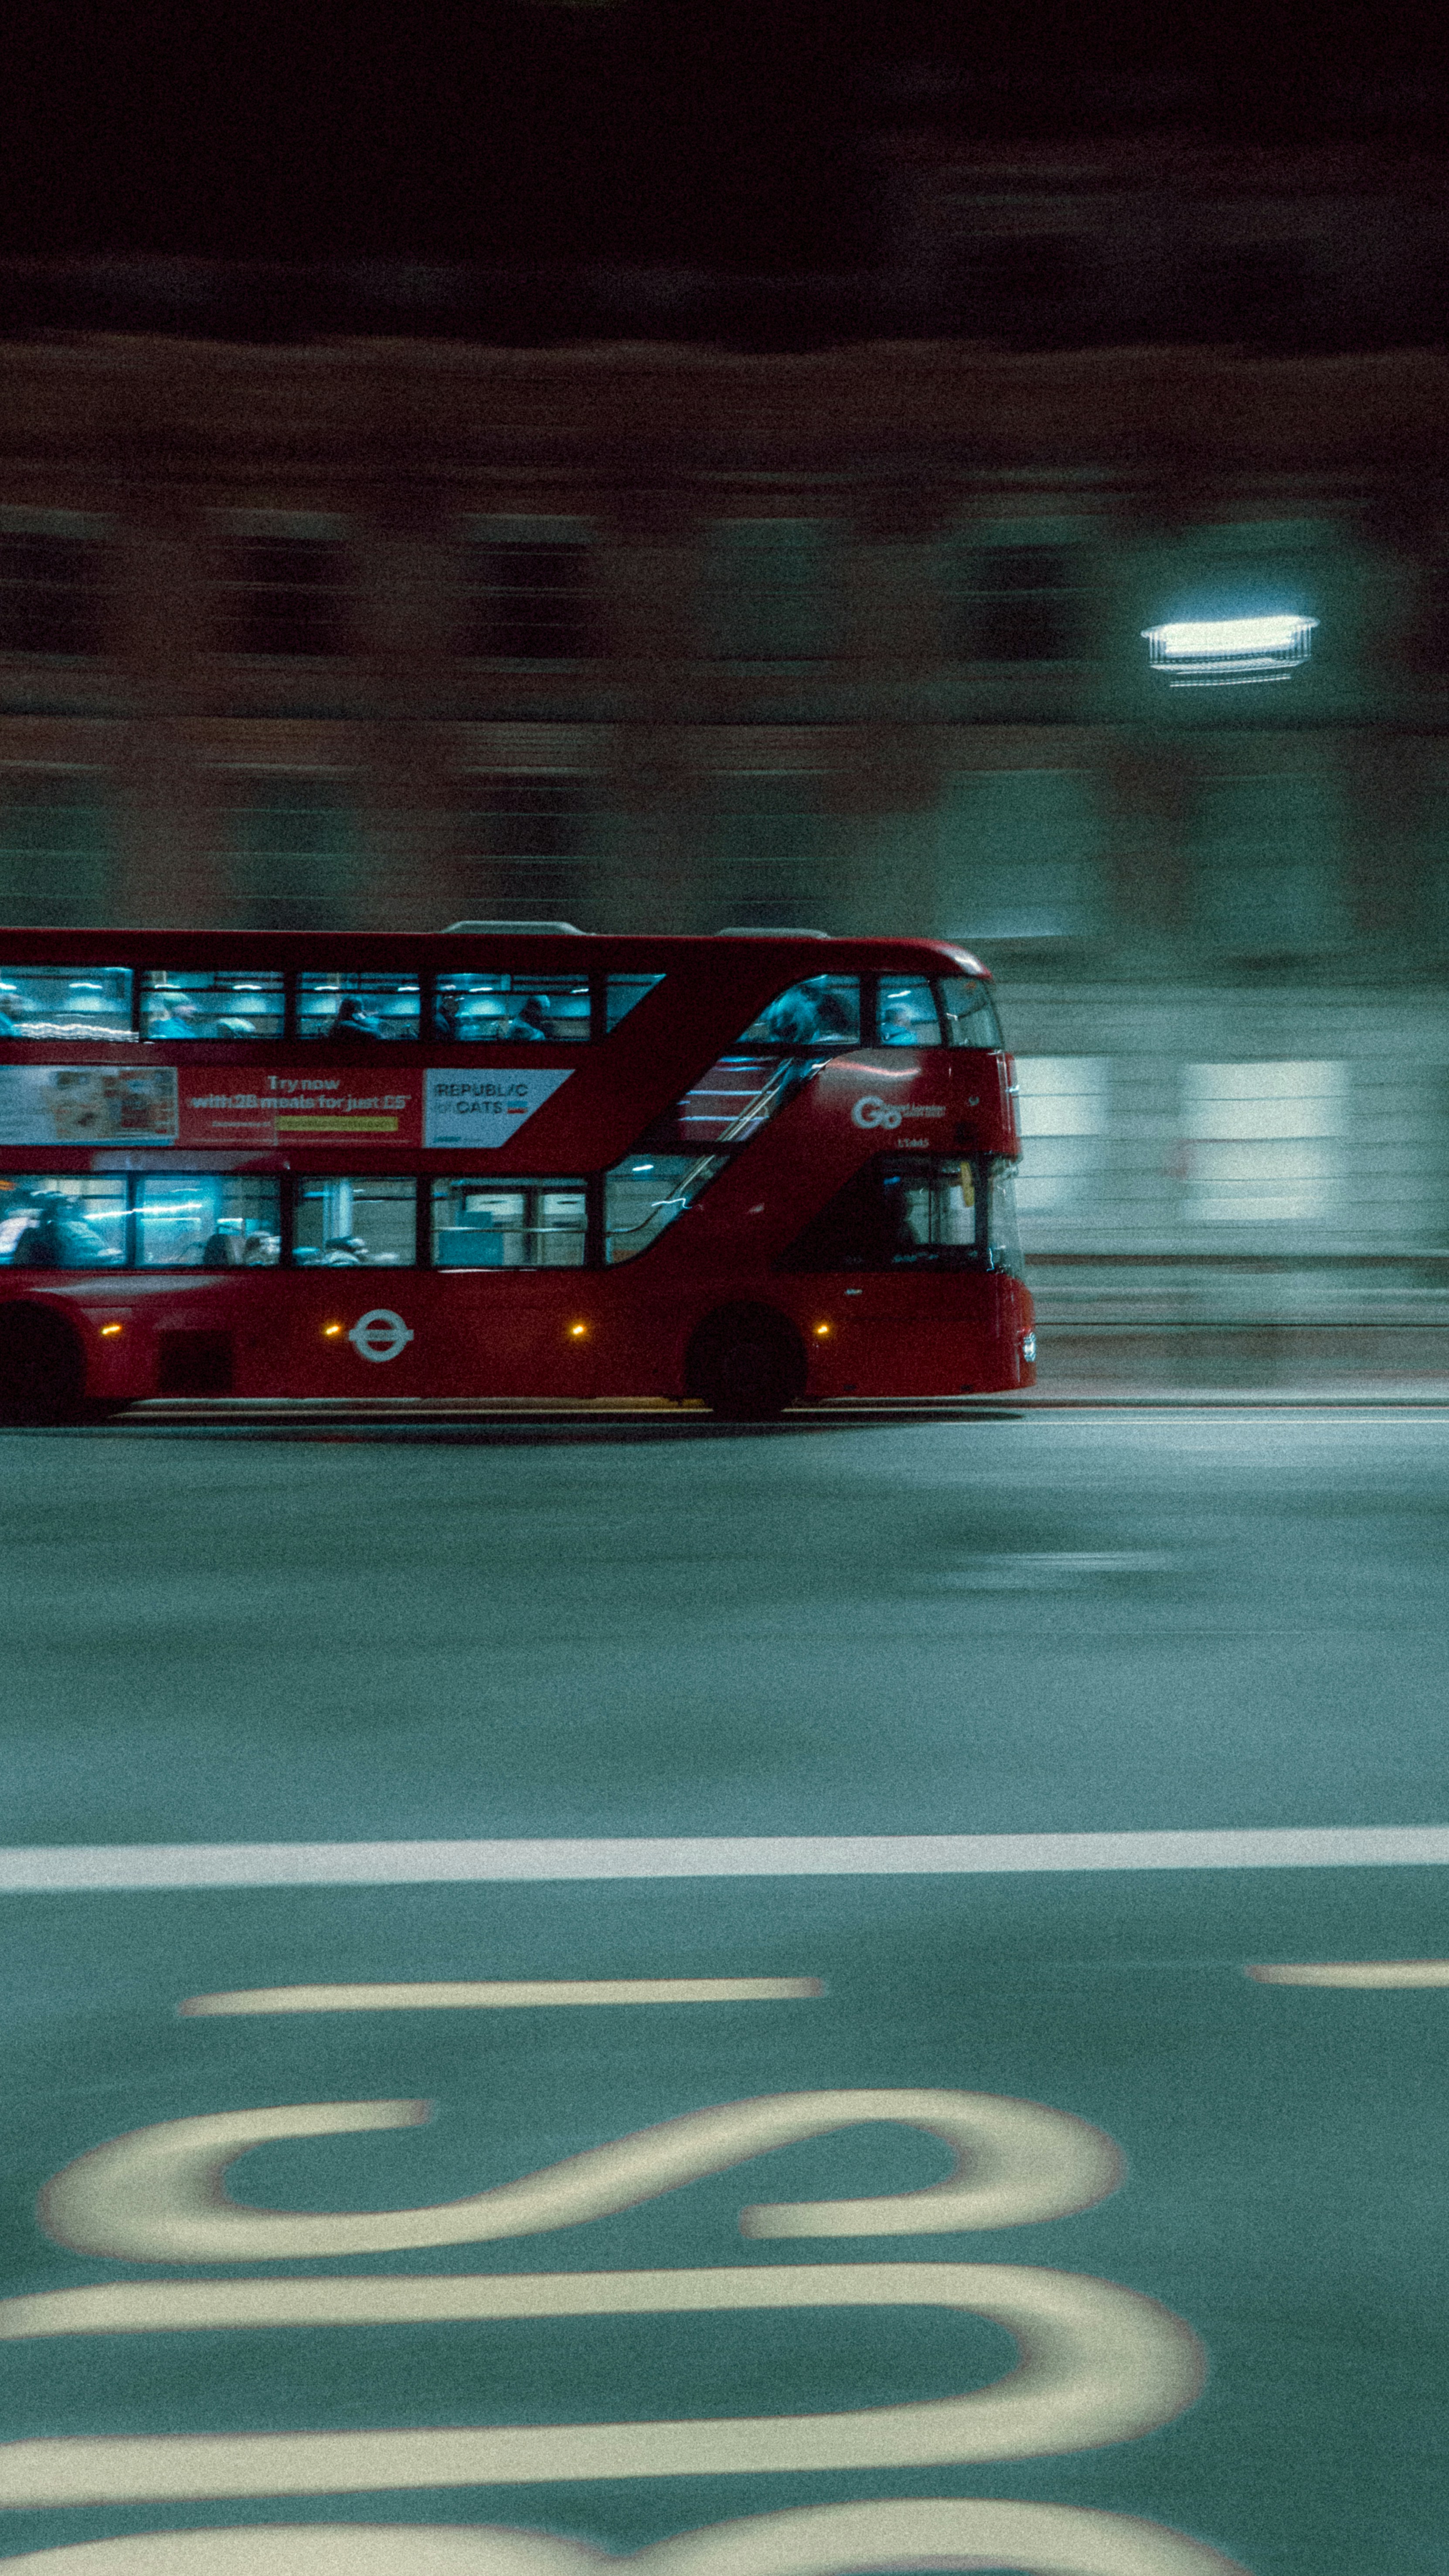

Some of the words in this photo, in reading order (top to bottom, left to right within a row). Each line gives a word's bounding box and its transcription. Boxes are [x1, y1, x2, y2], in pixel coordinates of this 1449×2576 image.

[267, 1075, 299, 1093] Try
[302, 1079, 340, 1090] now
[435, 1083, 529, 1097] REPUBLIC
[190, 1093, 231, 1109] with
[260, 1093, 315, 1109] meals
[318, 1094, 344, 1109] for
[342, 1094, 379, 1113] just
[456, 1101, 503, 1114] CATS
[851, 1095, 902, 1129] Go
